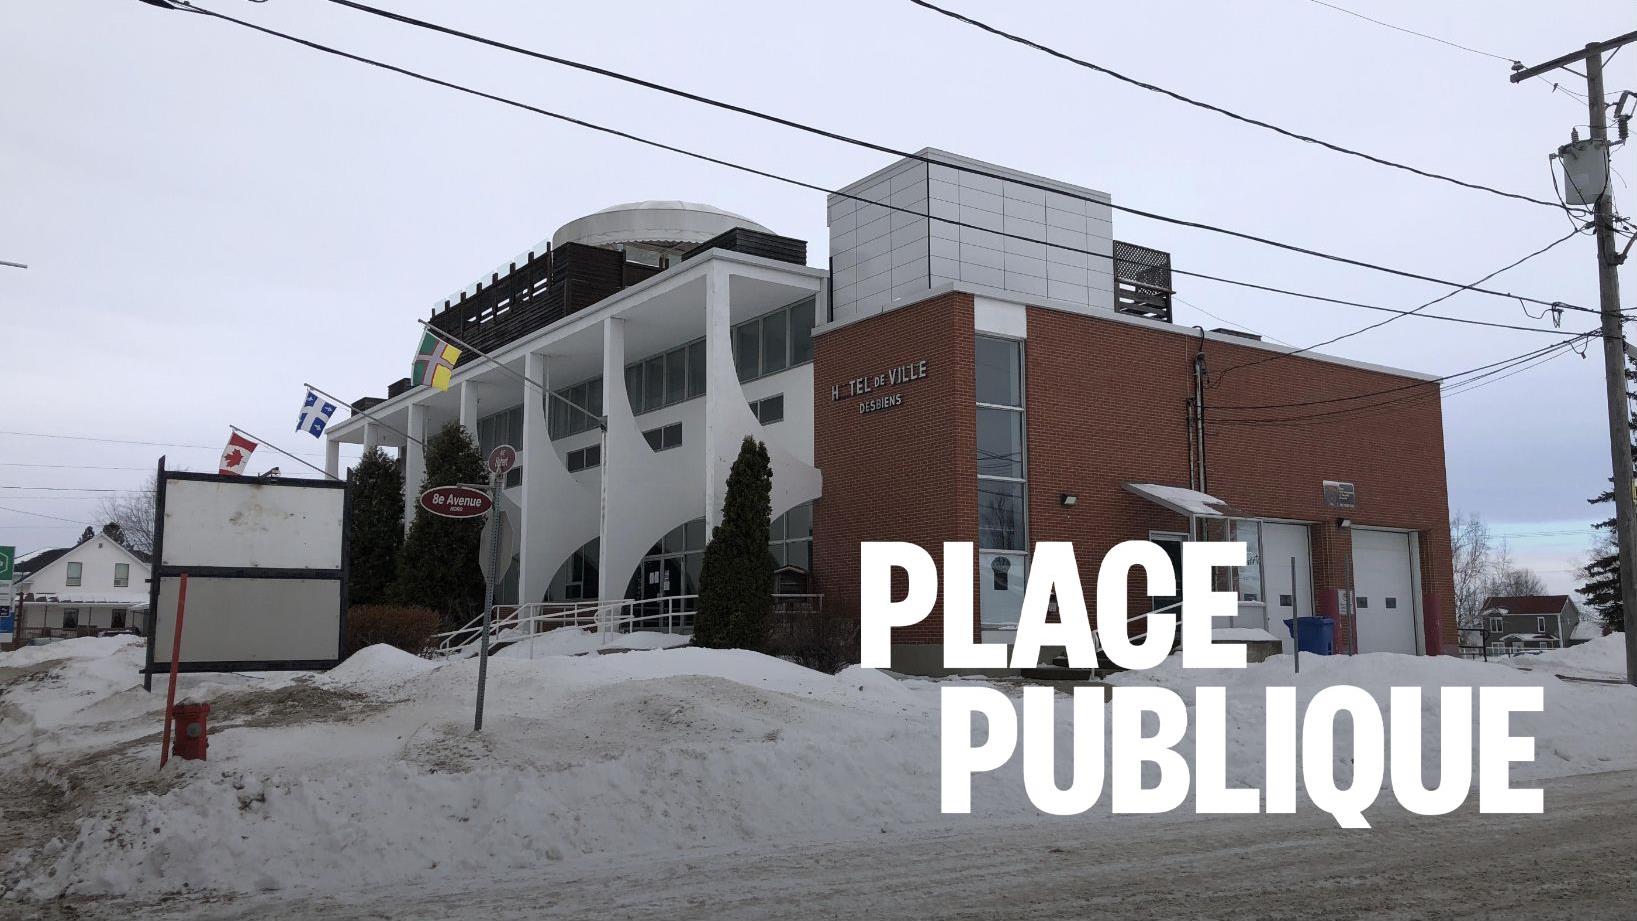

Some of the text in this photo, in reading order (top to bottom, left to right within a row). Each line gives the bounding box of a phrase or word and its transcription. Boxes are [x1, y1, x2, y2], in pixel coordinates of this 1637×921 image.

[874, 374, 885, 388] DE
[888, 360, 928, 385] VILLE
[859, 393, 902, 414] DESBIENS
[432, 493, 482, 507] 8e Avenue
